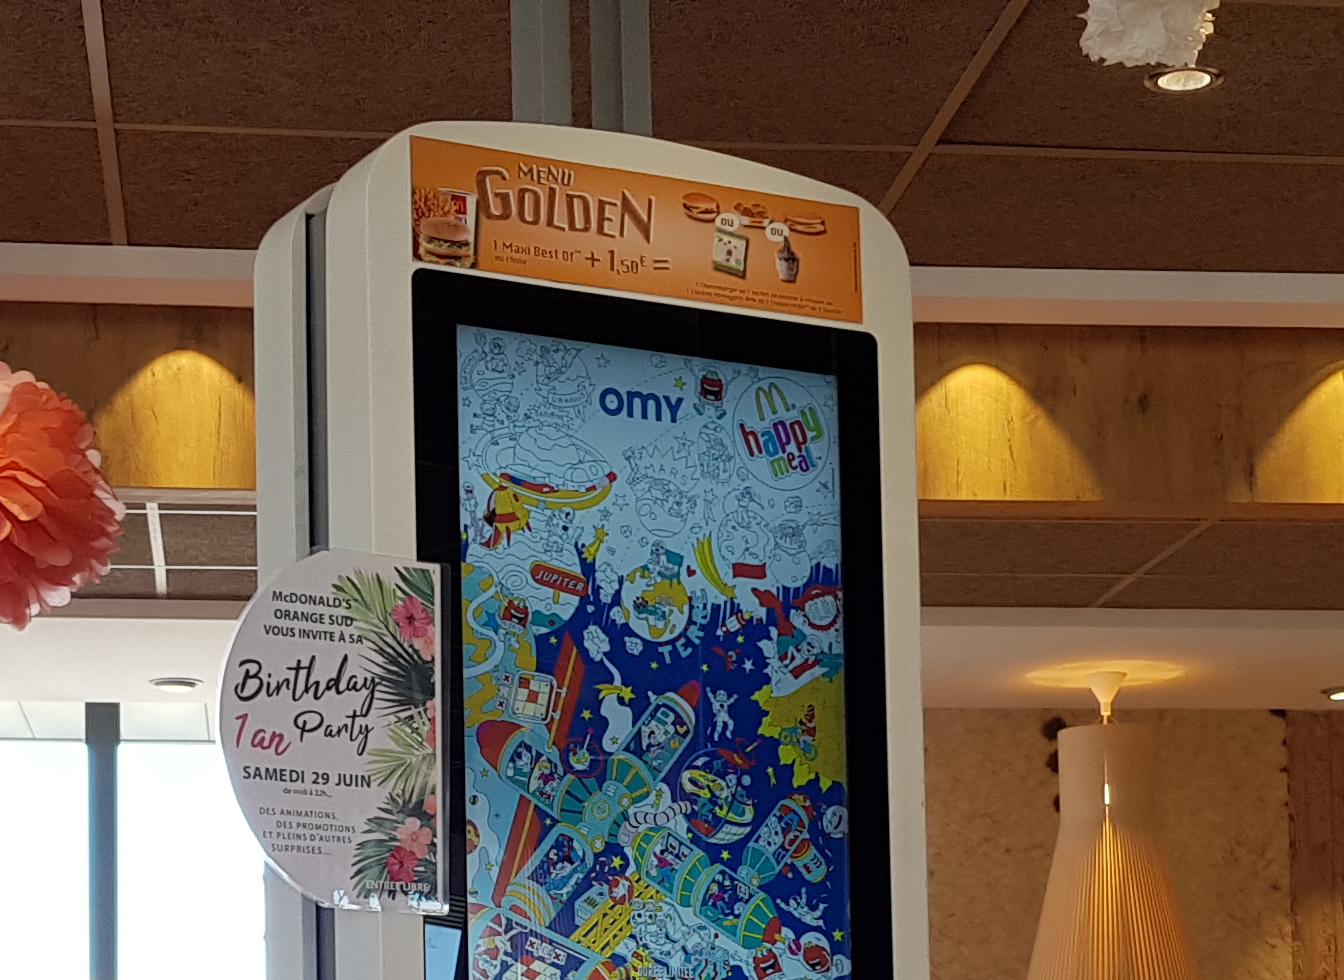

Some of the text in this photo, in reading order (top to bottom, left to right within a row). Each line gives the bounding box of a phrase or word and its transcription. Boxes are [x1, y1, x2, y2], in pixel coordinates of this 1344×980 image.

[517, 162, 575, 187] MENU
[476, 165, 656, 245] GOLDEN
[502, 240, 532, 256] Maxi
[533, 245, 560, 261] Best
[738, 404, 825, 459] happy
[768, 449, 820, 480] meal
[534, 569, 586, 593] JUPITER
[271, 590, 353, 610] McDONALD'S
[273, 608, 354, 628] ORANGE SUD
[263, 624, 296, 638] VOUS
[298, 628, 335, 643] INVITE
[349, 633, 364, 645] SA
[234, 653, 379, 717] Birthday
[234, 712, 293, 756] 1 an
[293, 709, 375, 757] Party
[242, 765, 372, 789] SAMEDI 29 JUIN
[258, 806, 277, 816] DES
[275, 820, 356, 834] DES PROMOTIONS
[276, 832, 308, 842] PLEINS
